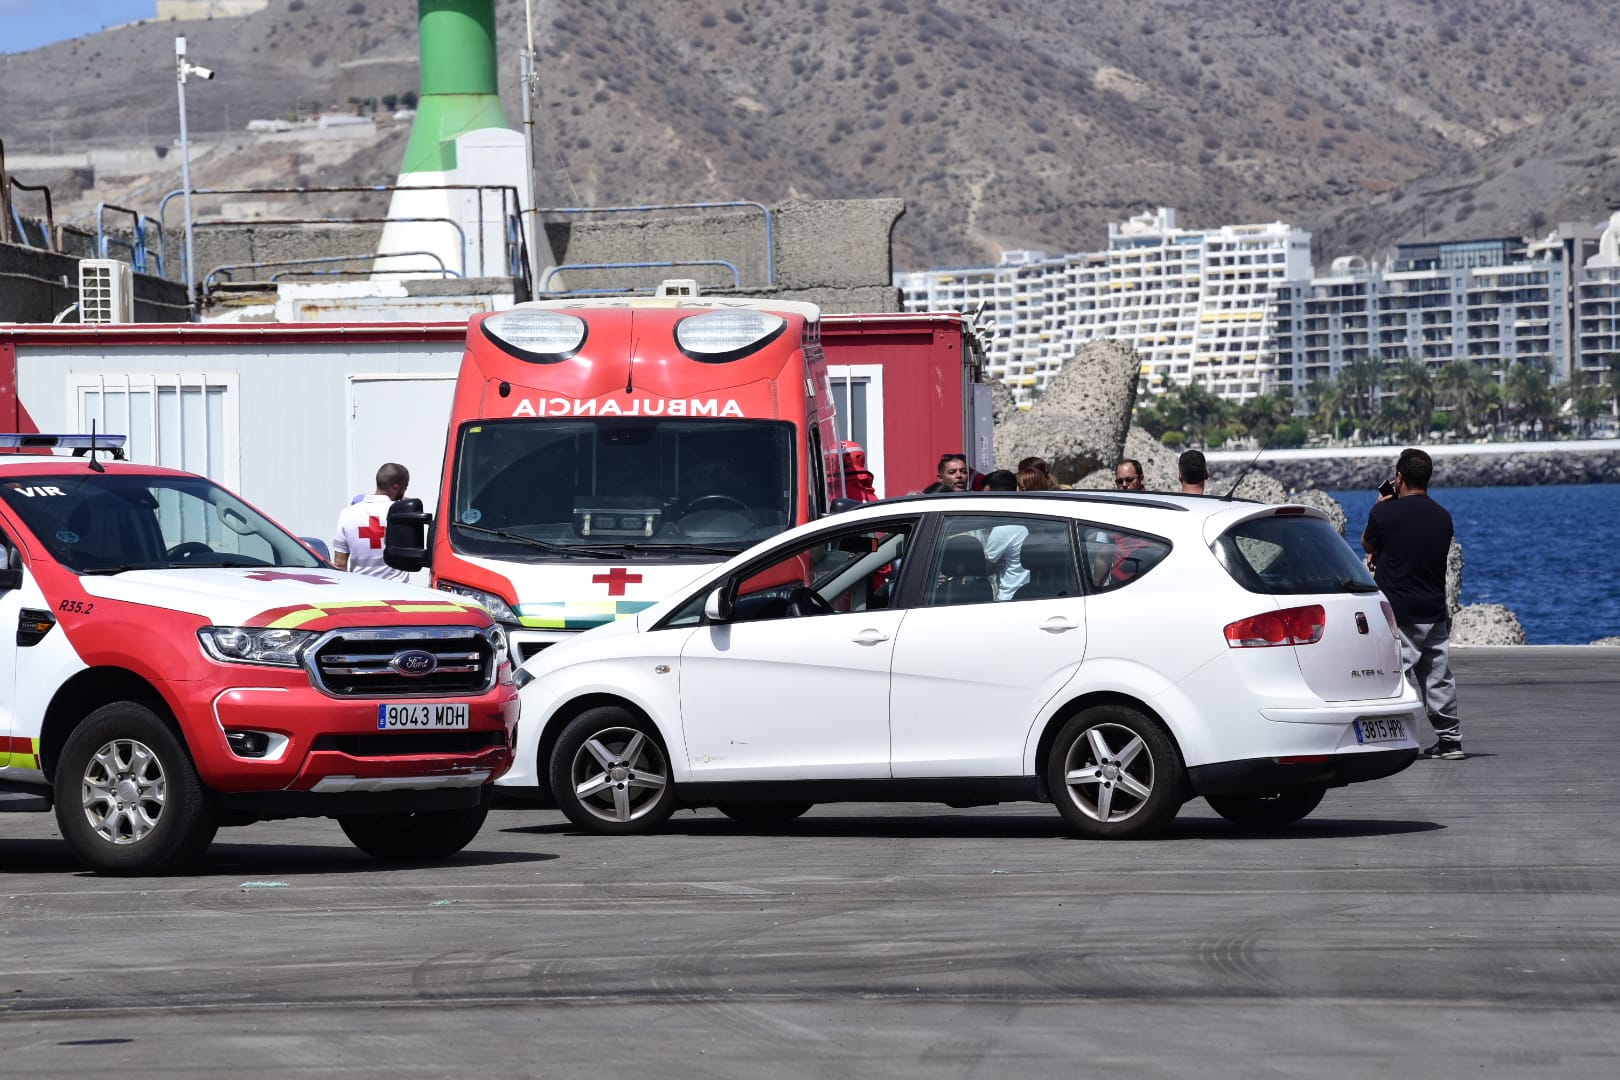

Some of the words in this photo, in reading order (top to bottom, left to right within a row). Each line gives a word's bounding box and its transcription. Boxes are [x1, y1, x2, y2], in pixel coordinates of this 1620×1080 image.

[14, 486, 67, 498] VIR
[59, 600, 94, 615] R35.2
[406, 656, 428, 670] Ford
[388, 706, 430, 726] 9043
[435, 706, 465, 726] MDH
[1362, 720, 1387, 739] 3815
